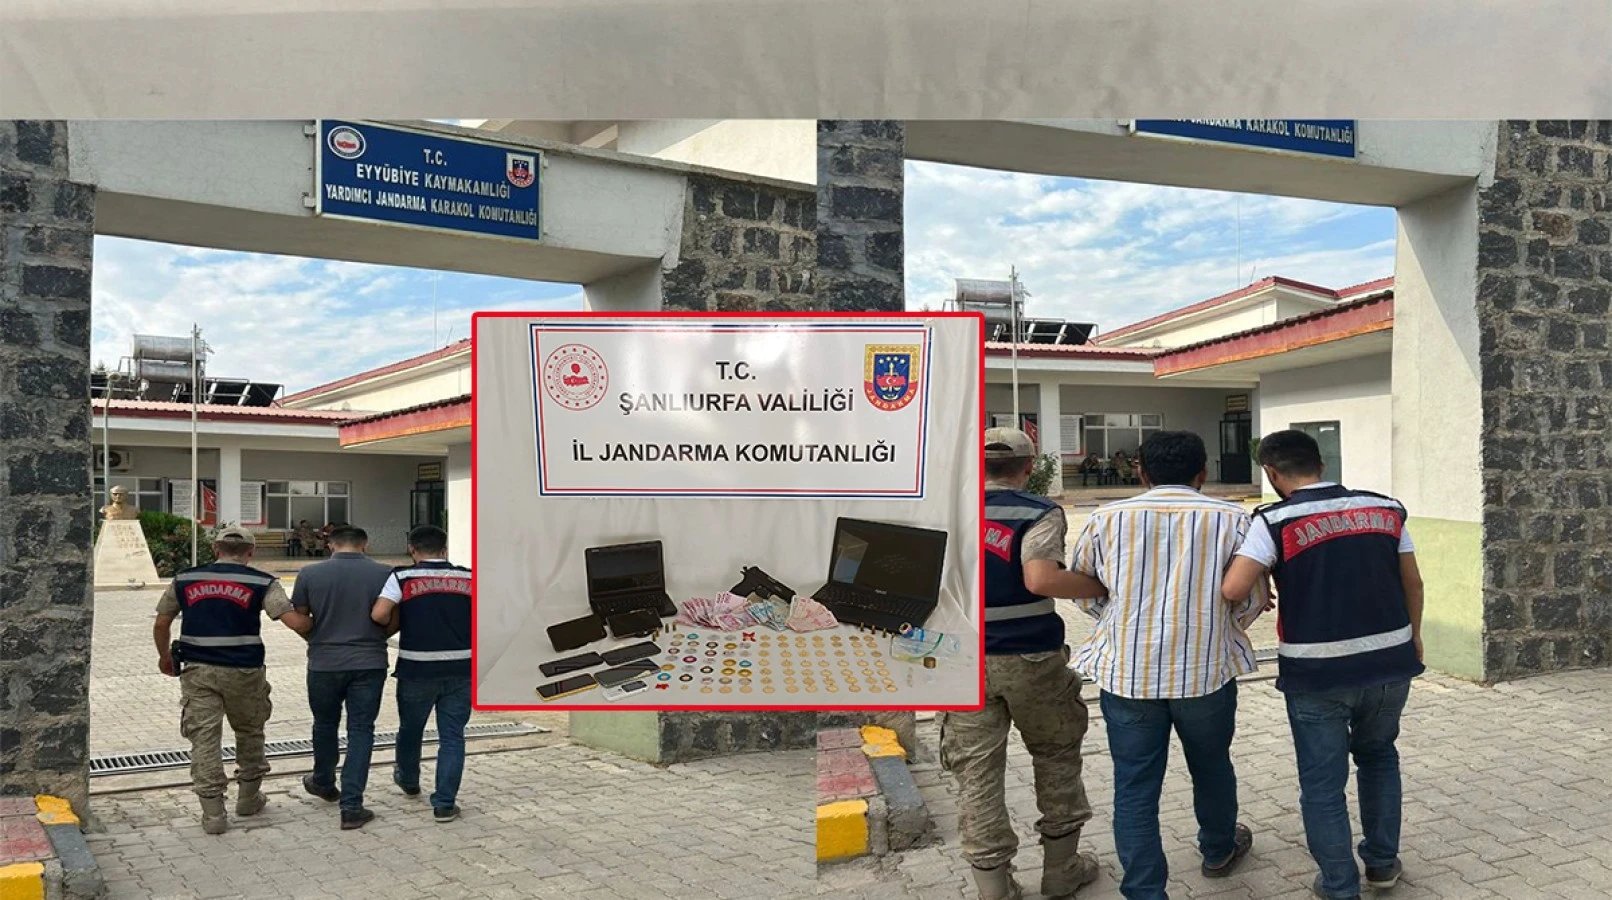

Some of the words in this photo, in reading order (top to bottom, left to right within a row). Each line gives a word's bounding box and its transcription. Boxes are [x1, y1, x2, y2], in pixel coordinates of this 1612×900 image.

[1246, 119, 1290, 136] KARAKOL
[1294, 124, 1354, 145] KOMUTANLIĞI
[423, 149, 447, 166] T.C.
[356, 163, 419, 186] EYYÜBİYE
[424, 172, 510, 200] KAYMAKAMLIĞI
[325, 183, 372, 205] YARDIMCI
[376, 193, 427, 212] JANDARMA
[430, 199, 475, 219] KARAKOL
[478, 205, 537, 226] KOMUTANLIĞI
[716, 361, 756, 380] T.C.
[619, 392, 752, 416] ŞANLIURFA
[756, 388, 855, 412] VALİLİĞİ
[573, 438, 593, 462] İL
[599, 443, 729, 463] JANDARMA
[735, 440, 896, 463] KOMUTANLIĞI
[1294, 512, 1395, 546] JANDARMA
[188, 583, 252, 603] JANDARMA
